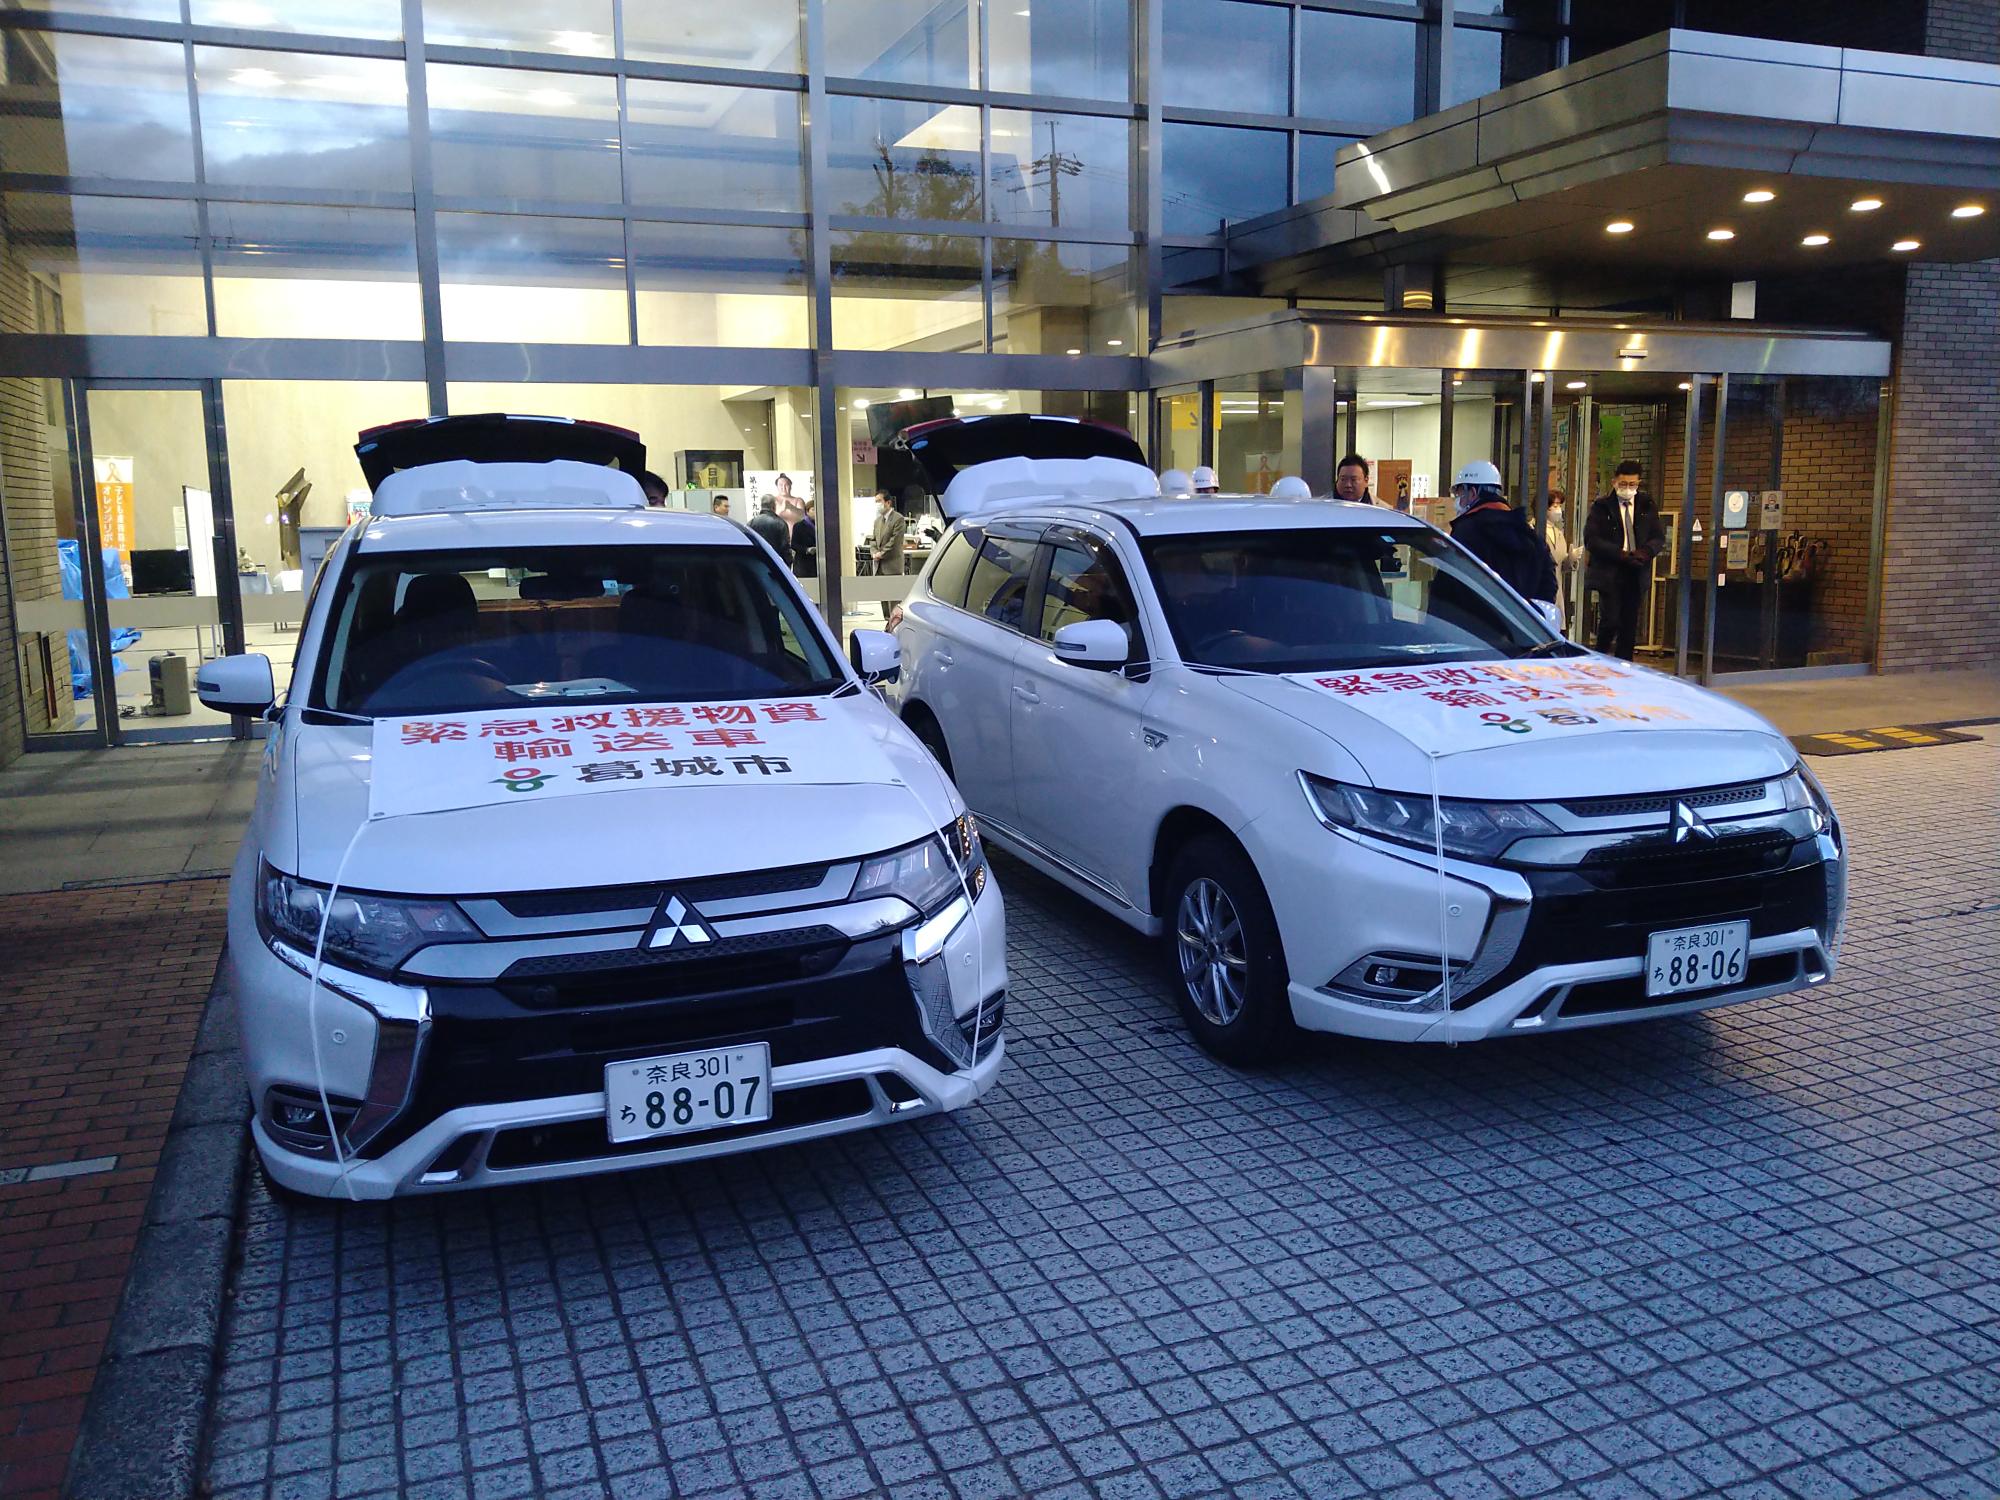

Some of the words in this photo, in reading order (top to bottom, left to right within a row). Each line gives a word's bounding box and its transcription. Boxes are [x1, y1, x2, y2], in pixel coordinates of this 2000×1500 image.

[400, 702, 828, 745] 緊急救援物資
[492, 727, 767, 763] 輸送車
[572, 754, 794, 784] 葛城市
[1653, 966, 1665, 982] ち
[1668, 947, 1742, 987] 88-06
[619, 1104, 637, 1125] ち
[645, 1076, 761, 1130] 88-07
